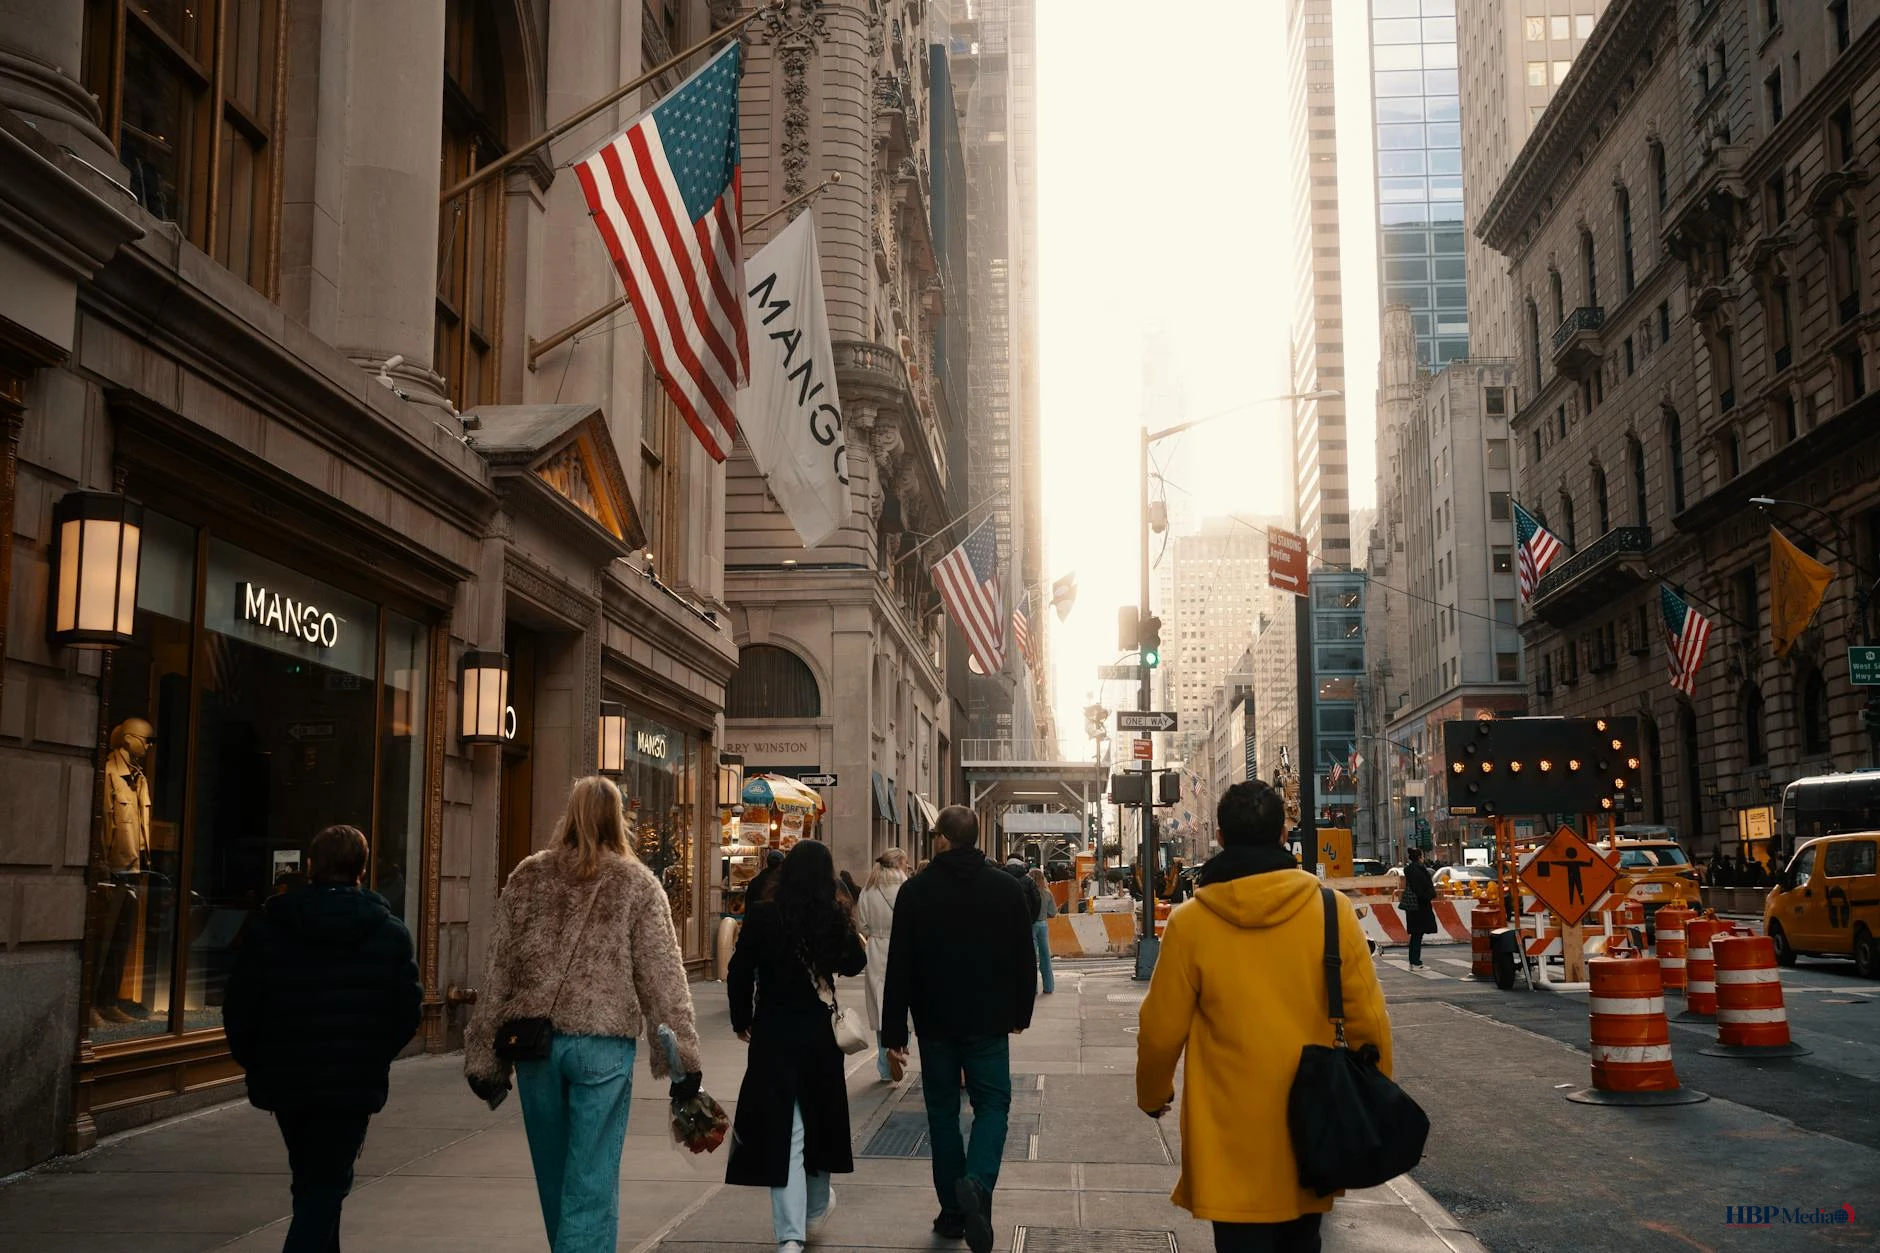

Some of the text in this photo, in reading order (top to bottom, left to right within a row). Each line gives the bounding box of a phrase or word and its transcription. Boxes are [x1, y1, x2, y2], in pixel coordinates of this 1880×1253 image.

[1278, 534, 1302, 552] STANDING
[245, 582, 338, 648] MANGO
[1855, 672, 1871, 681] Hwy
[1125, 717, 1169, 727] ONE WAY
[637, 730, 666, 759] MANGO
[725, 742, 808, 753] RRY WINSTON
